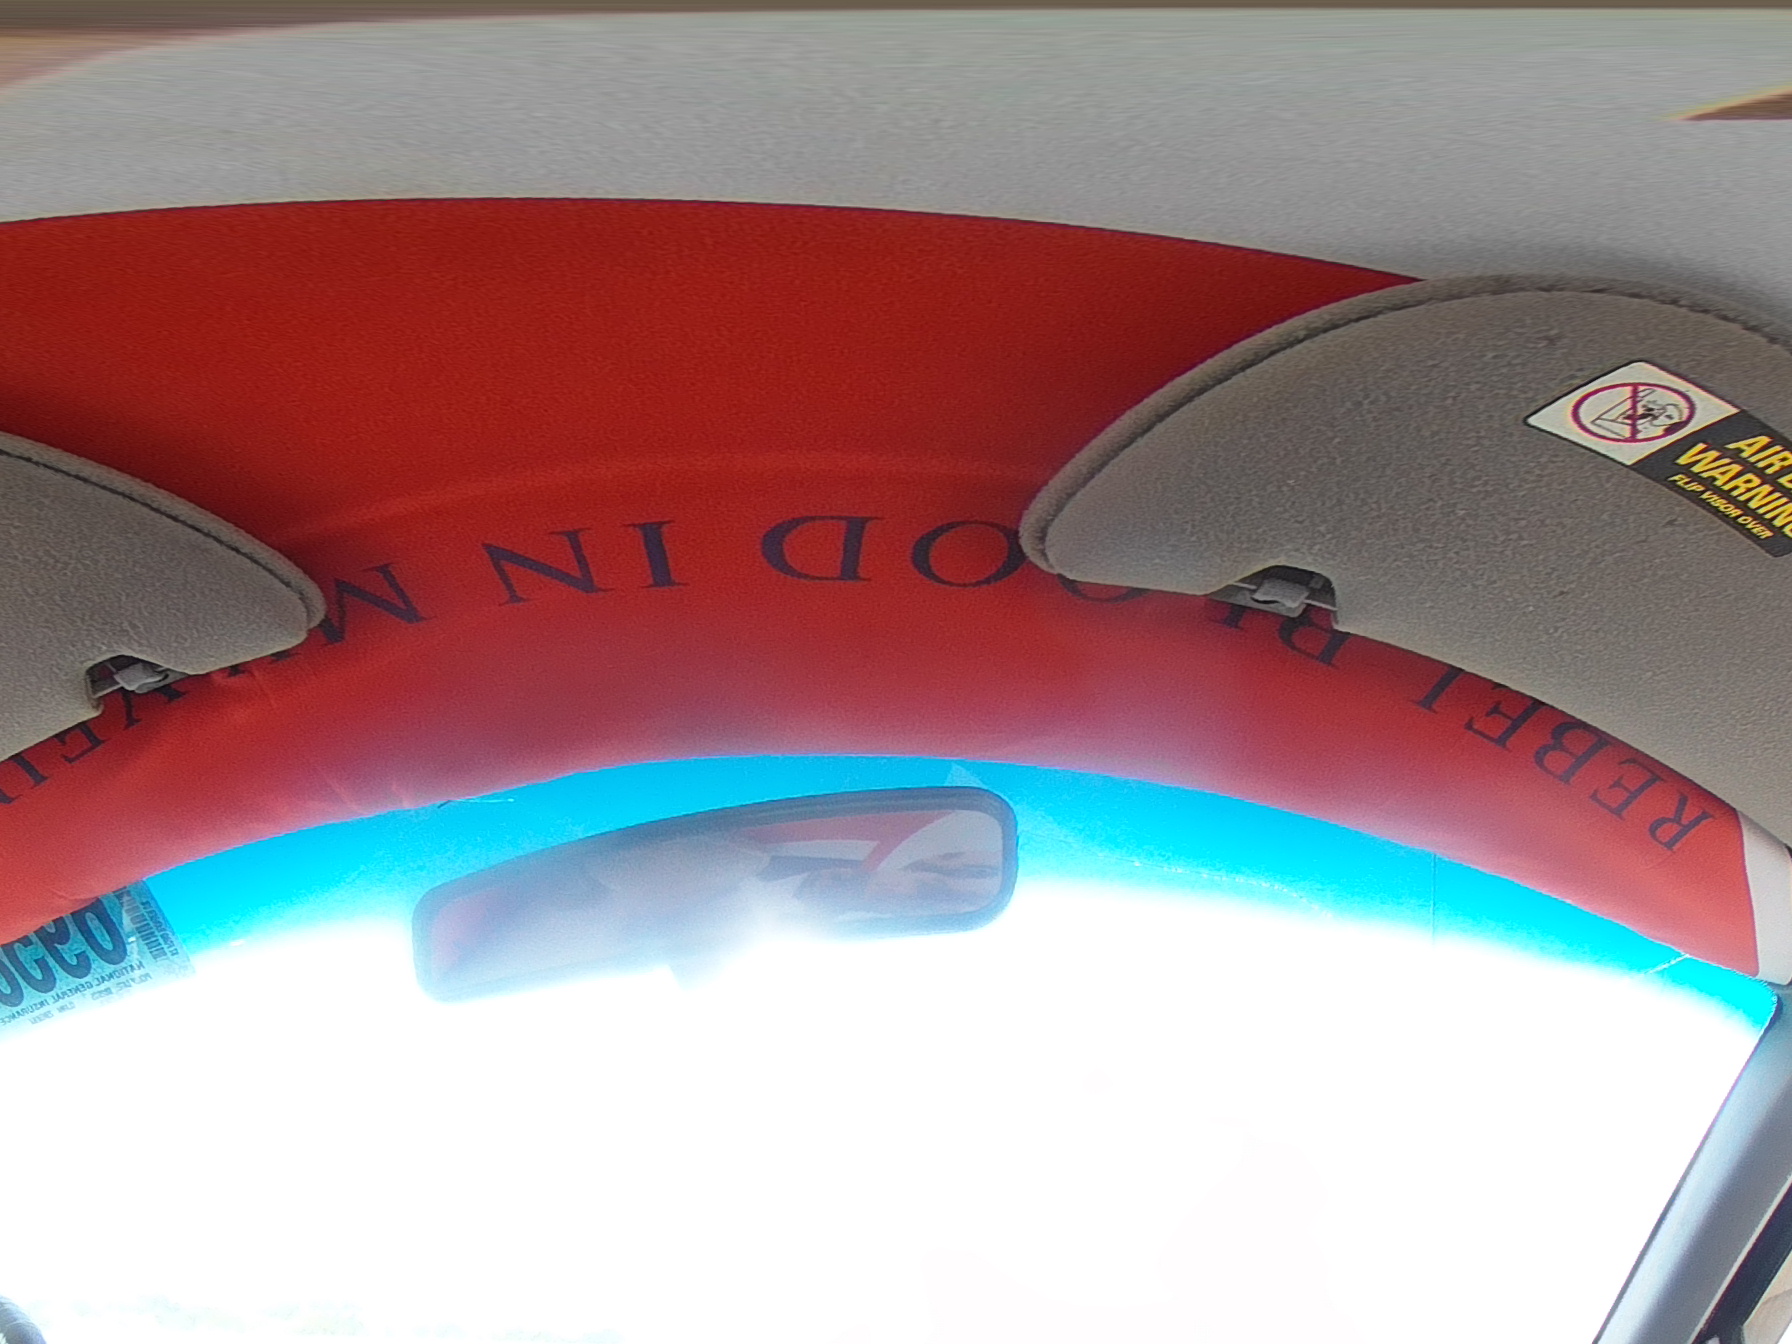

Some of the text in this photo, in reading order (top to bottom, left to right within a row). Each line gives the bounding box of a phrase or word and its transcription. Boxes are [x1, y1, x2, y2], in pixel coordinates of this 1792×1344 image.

[1667, 474, 1775, 539] FLIP VISOR OVER
[481, 520, 689, 605] IN
[760, 515, 1352, 668] BOD
